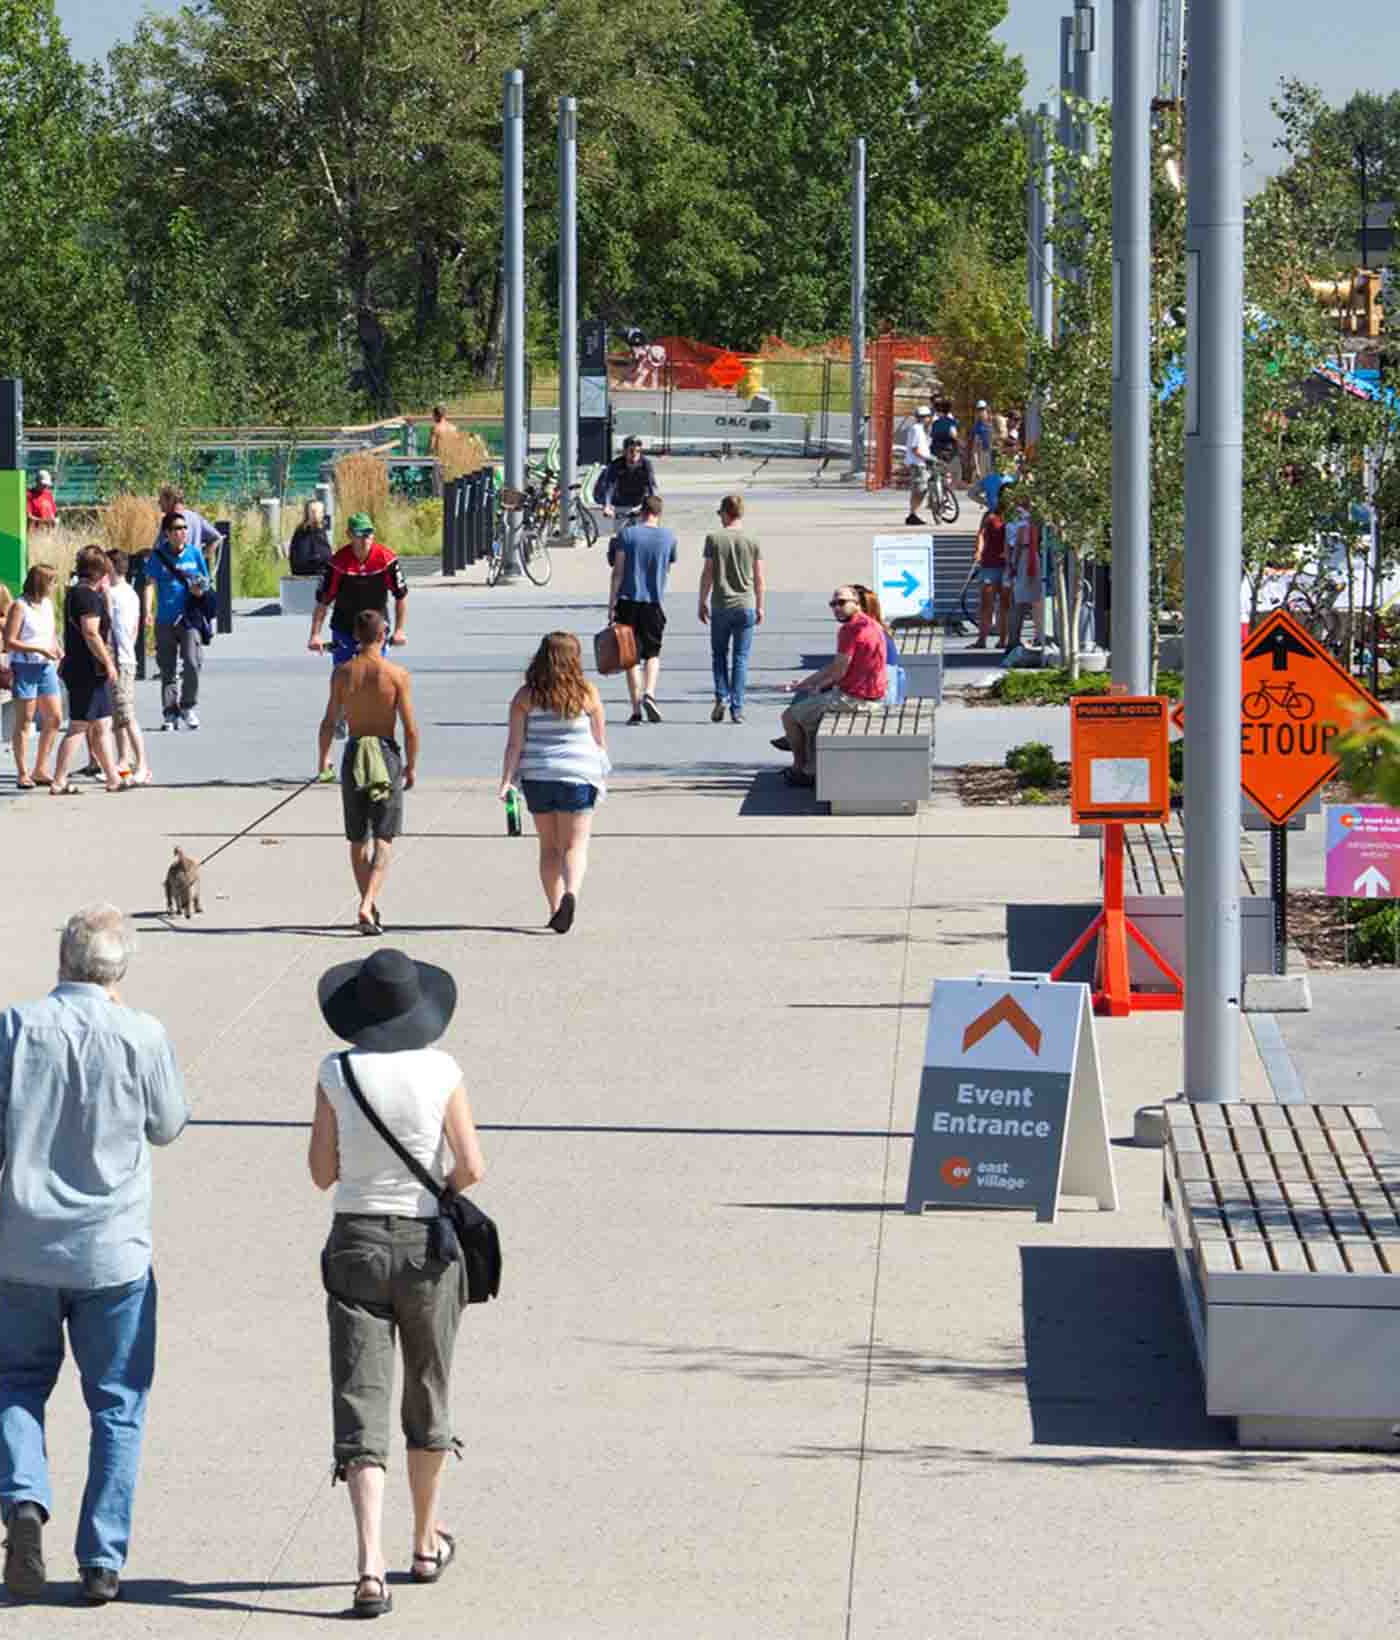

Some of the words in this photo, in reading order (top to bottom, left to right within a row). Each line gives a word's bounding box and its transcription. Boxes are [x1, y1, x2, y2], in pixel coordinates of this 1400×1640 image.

[1078, 705, 1116, 714] PUBLIC
[1120, 705, 1161, 714] NOTICE
[1240, 722, 1339, 755] ETOUR
[957, 1083, 1033, 1108] Event
[932, 1111, 1051, 1138] Entrance
[952, 1167, 971, 1177] ev
[976, 1161, 1009, 1175] east
[976, 1173, 1025, 1191] village
